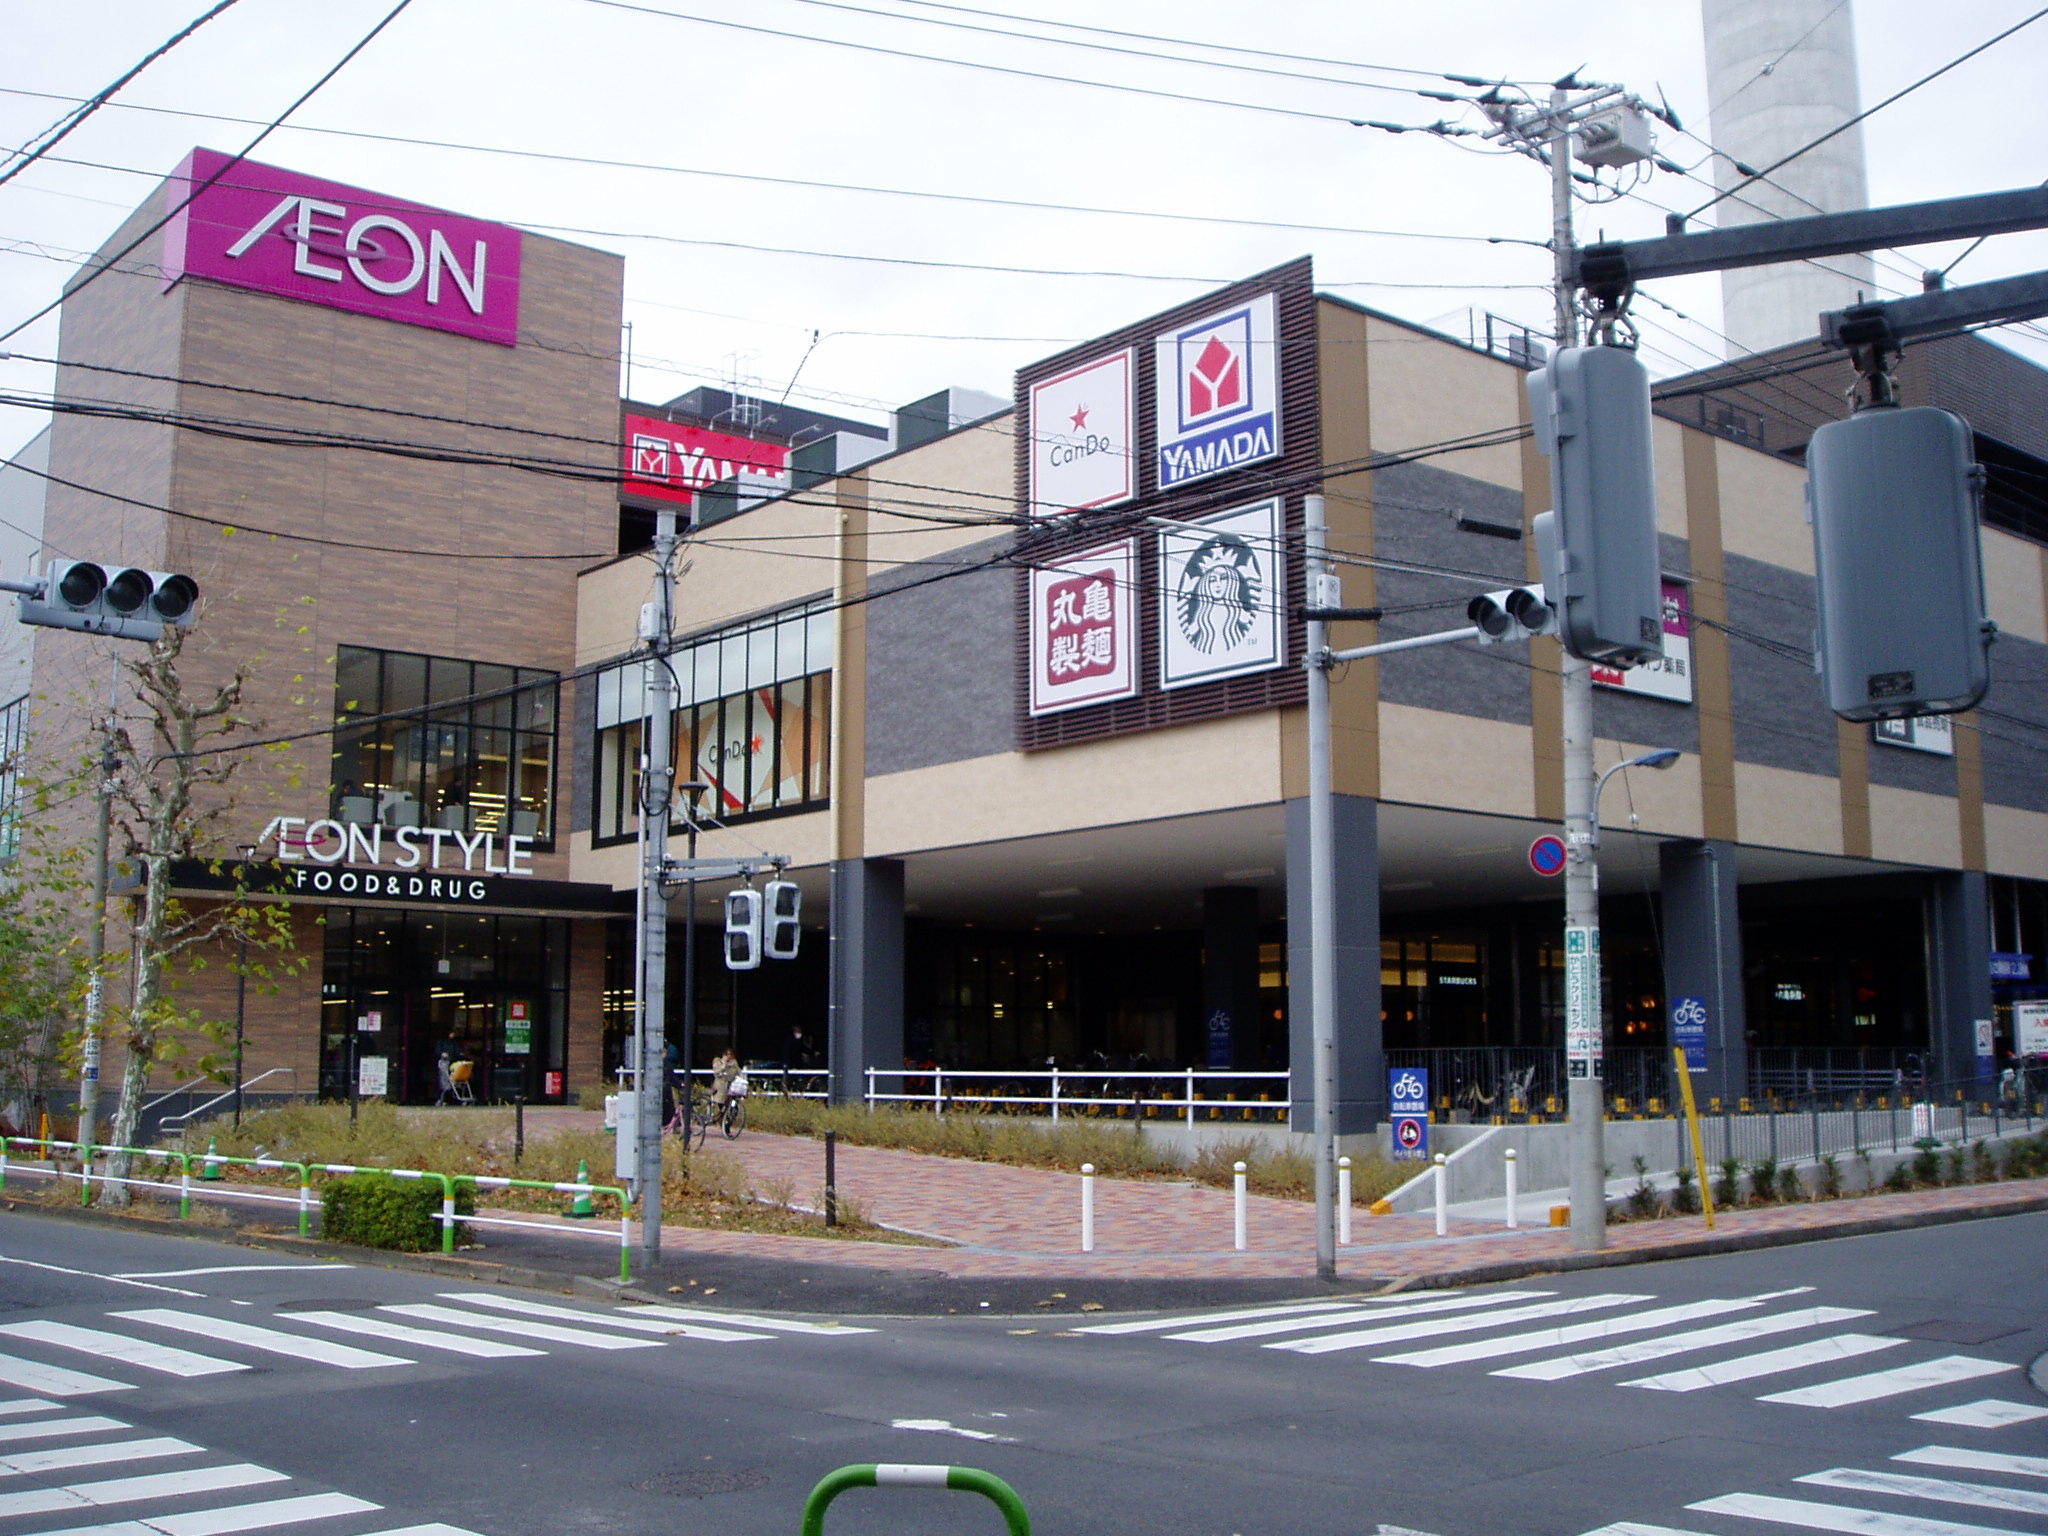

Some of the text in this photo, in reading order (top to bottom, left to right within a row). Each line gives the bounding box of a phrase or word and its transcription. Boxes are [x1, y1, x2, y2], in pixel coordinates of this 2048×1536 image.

[1050, 434, 1110, 467] CanDo
[1163, 426, 1271, 481] YAMADA
[1050, 579, 1112, 630] 丸亀
[1050, 626, 1112, 676] 製麺
[395, 825, 533, 876] STYLE
[297, 870, 487, 900] FOOD&DRUG
[1439, 975, 1477, 986] STARBUCKS
